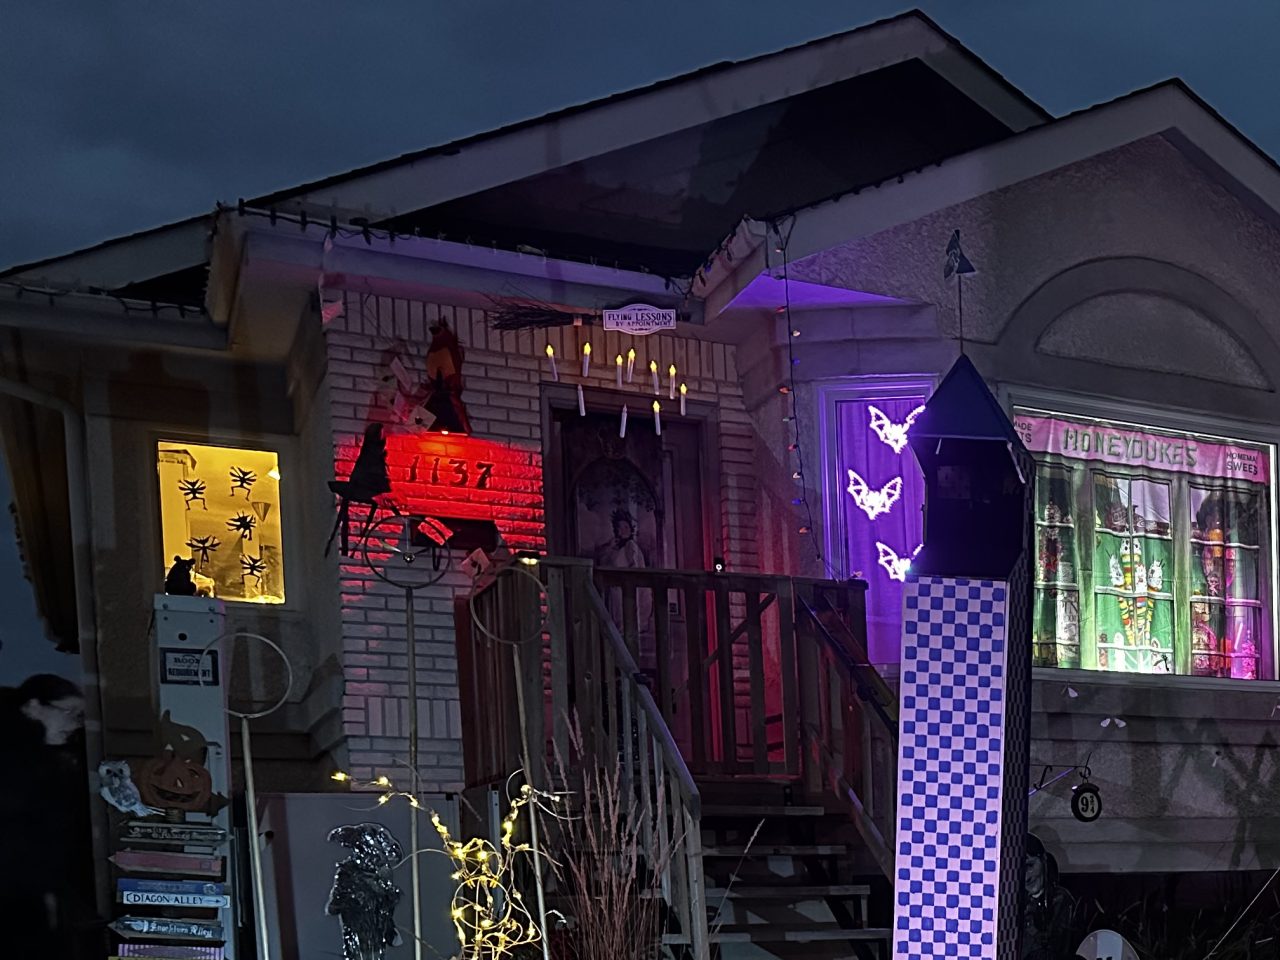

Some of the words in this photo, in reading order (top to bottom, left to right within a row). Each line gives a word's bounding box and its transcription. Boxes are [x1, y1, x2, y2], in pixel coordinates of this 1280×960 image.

[608, 313, 632, 321] FLYING
[635, 312, 673, 321] LESSONS
[1064, 427, 1198, 467] HONEYDUKES
[409, 455, 495, 489] 1137
[133, 894, 170, 903] DIAGON
[173, 895, 204, 904] ALLEY
